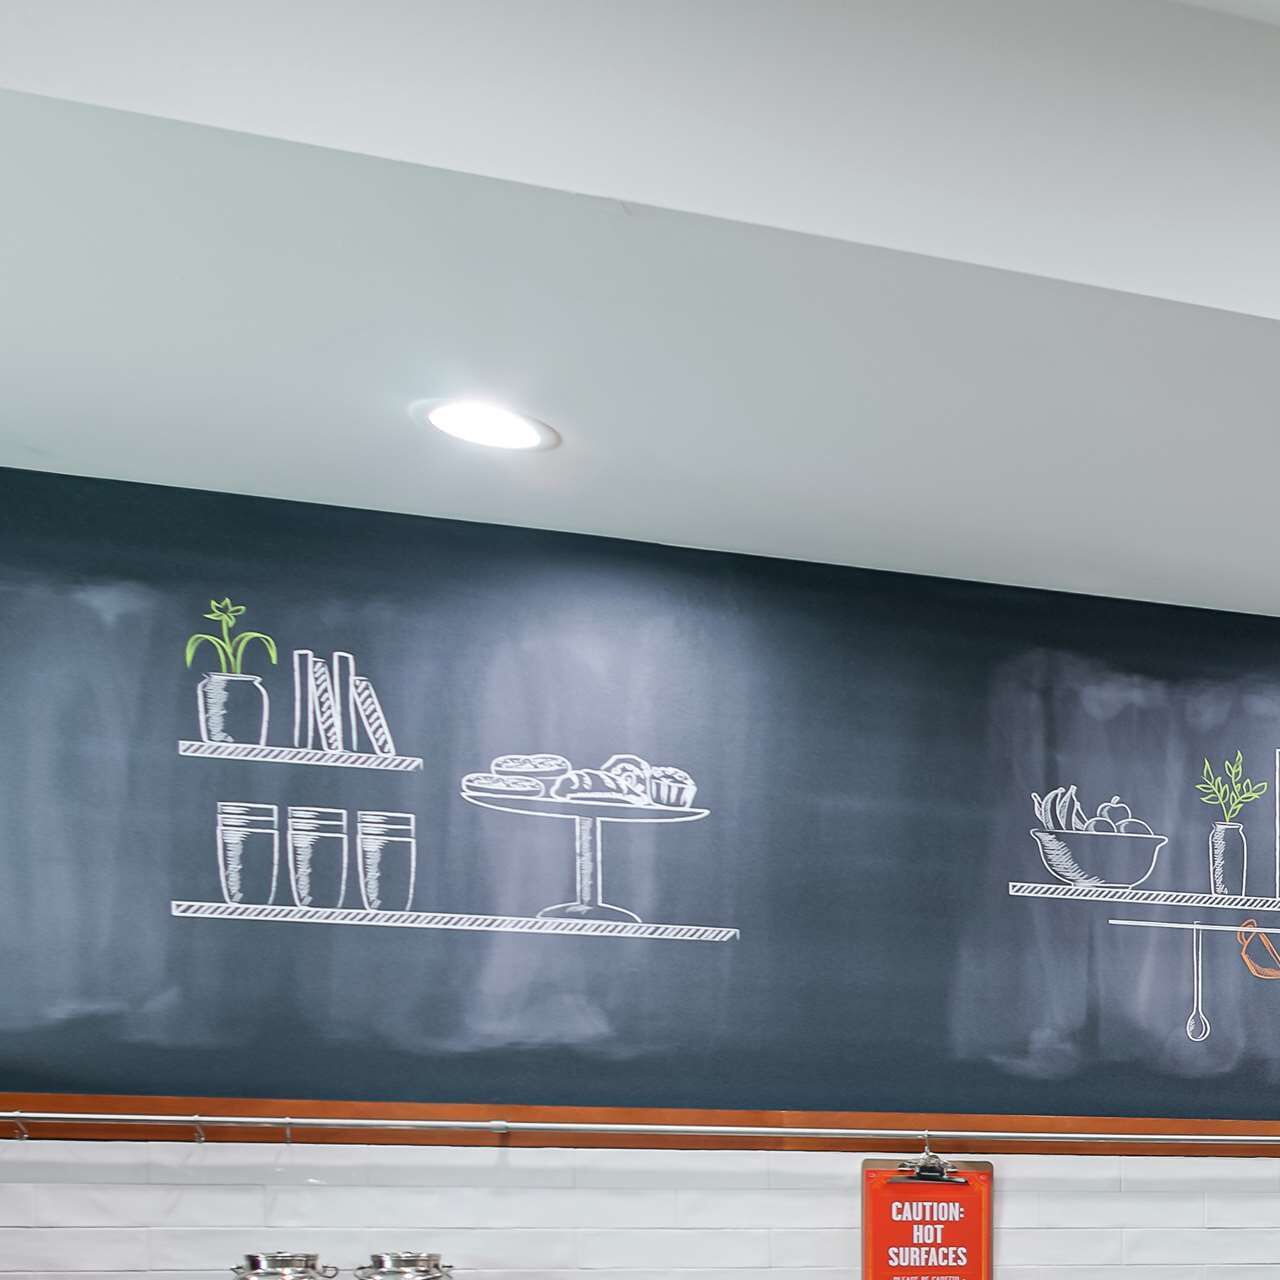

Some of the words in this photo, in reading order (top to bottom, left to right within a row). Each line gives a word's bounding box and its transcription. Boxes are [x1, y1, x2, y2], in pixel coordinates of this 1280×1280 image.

[891, 1201, 966, 1222] CAUTION:
[912, 1224, 945, 1244] HOT
[888, 1246, 968, 1267] SURFACES
